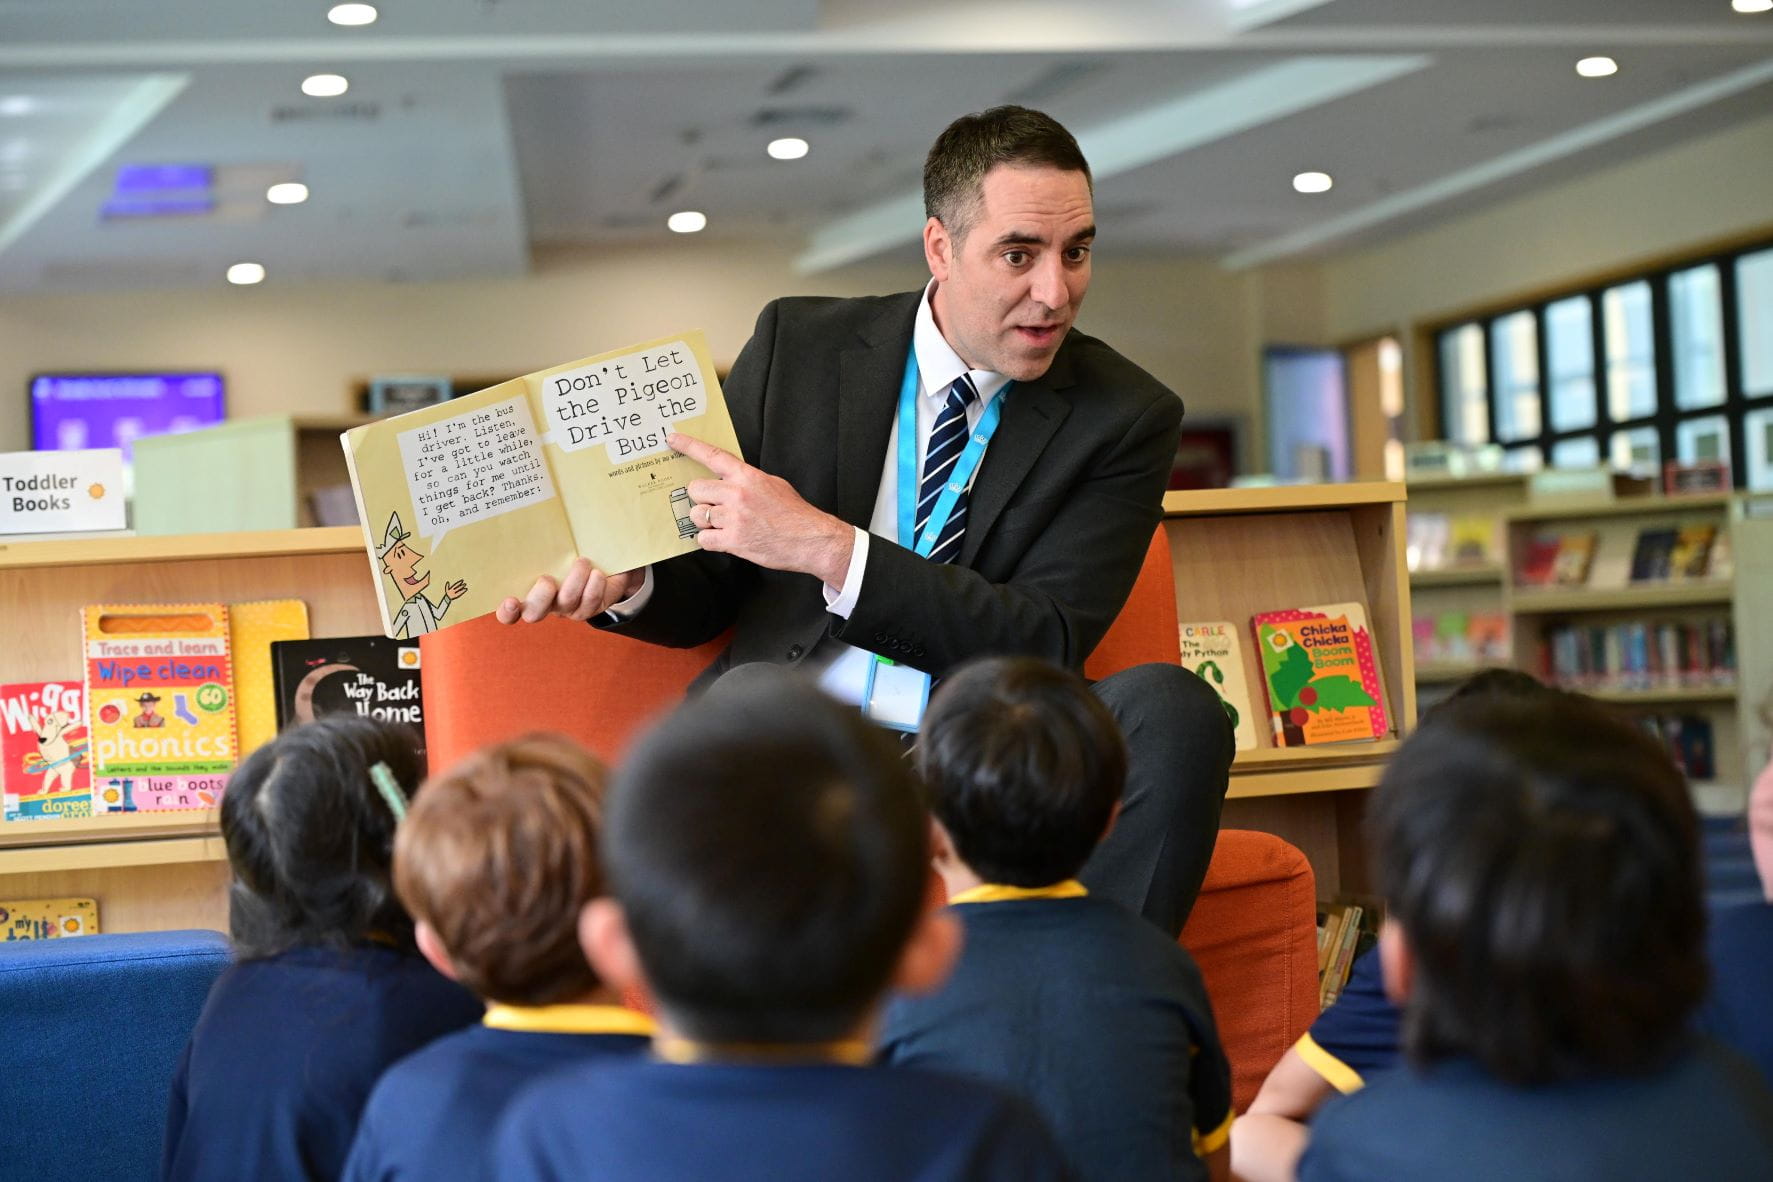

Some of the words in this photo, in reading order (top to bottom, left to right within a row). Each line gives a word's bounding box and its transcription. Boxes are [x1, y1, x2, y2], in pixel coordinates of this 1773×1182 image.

[555, 364, 628, 396] Don't
[642, 350, 683, 374] Let
[556, 398, 600, 421] the
[615, 372, 698, 405] Pigeon
[418, 428, 438, 442] Hi!
[446, 422, 466, 434] I'm
[472, 413, 490, 426] the
[496, 405, 514, 417] bus
[568, 413, 642, 444] Drive
[658, 397, 696, 418] the
[418, 454, 445, 468] I've
[451, 445, 471, 459] got
[478, 440, 490, 449] to
[497, 427, 526, 443] leave
[421, 435, 467, 454] driver.
[474, 421, 516, 438] Listen,
[616, 426, 668, 456] Bus!
[414, 469, 433, 482] for
[456, 451, 494, 469] little
[499, 439, 534, 455] while,
[426, 480, 440, 490] so
[447, 472, 468, 483] can
[473, 463, 494, 479] you
[499, 450, 531, 467] watch
[2, 474, 78, 492] Toddler
[419, 486, 459, 505] things
[466, 477, 486, 491] for
[492, 472, 505, 483] me
[511, 458, 541, 475] until
[423, 508, 428, 516] I
[436, 501, 456, 514] get
[462, 486, 495, 504] back?
[501, 472, 544, 492] Thanks.
[12, 495, 71, 512] Books
[459, 504, 480, 518] and
[485, 485, 542, 510] remember:
[1182, 640, 1200, 648] The
[1300, 624, 1346, 636] Chicka
[1303, 634, 1349, 648] Chicka
[98, 642, 139, 656] Trace
[144, 640, 174, 654] and
[179, 640, 218, 654] learn
[1194, 649, 1229, 658] Python
[1312, 646, 1352, 658] Boom
[98, 660, 152, 688] Wipe
[157, 659, 220, 680] clean
[1316, 658, 1354, 669] Boom
[343, 682, 374, 701] Way
[376, 680, 420, 702] Back
[356, 672, 374, 685] The
[98, 729, 230, 771] phonics
[136, 764, 148, 772] and
[150, 764, 162, 772] the
[193, 764, 208, 772] they
[16, 920, 31, 932] my
